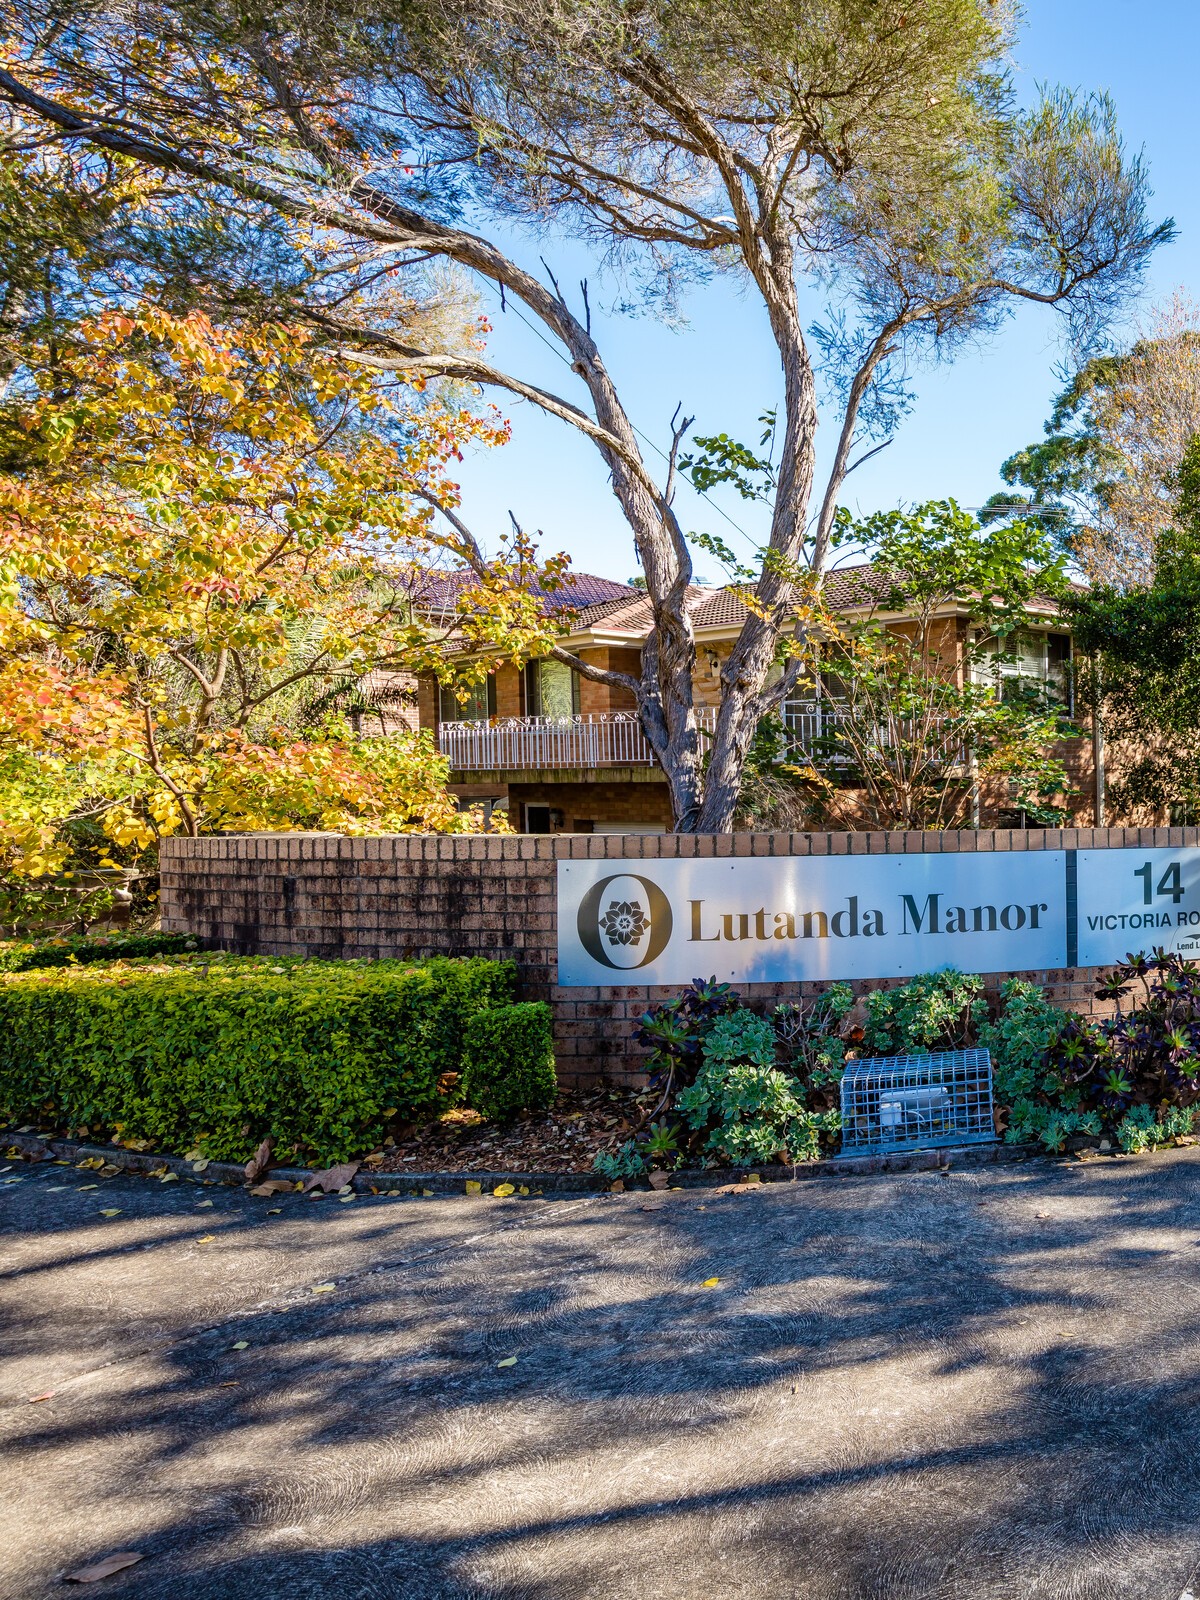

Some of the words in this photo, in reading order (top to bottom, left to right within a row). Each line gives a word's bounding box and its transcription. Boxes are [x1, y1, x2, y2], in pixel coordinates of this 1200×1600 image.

[1133, 861, 1185, 905] 14
[686, 895, 889, 943] Lutanda
[897, 892, 1049, 935] Manor
[1087, 912, 1172, 931] VICTORIA
[1176, 941, 1194, 951] Lend
